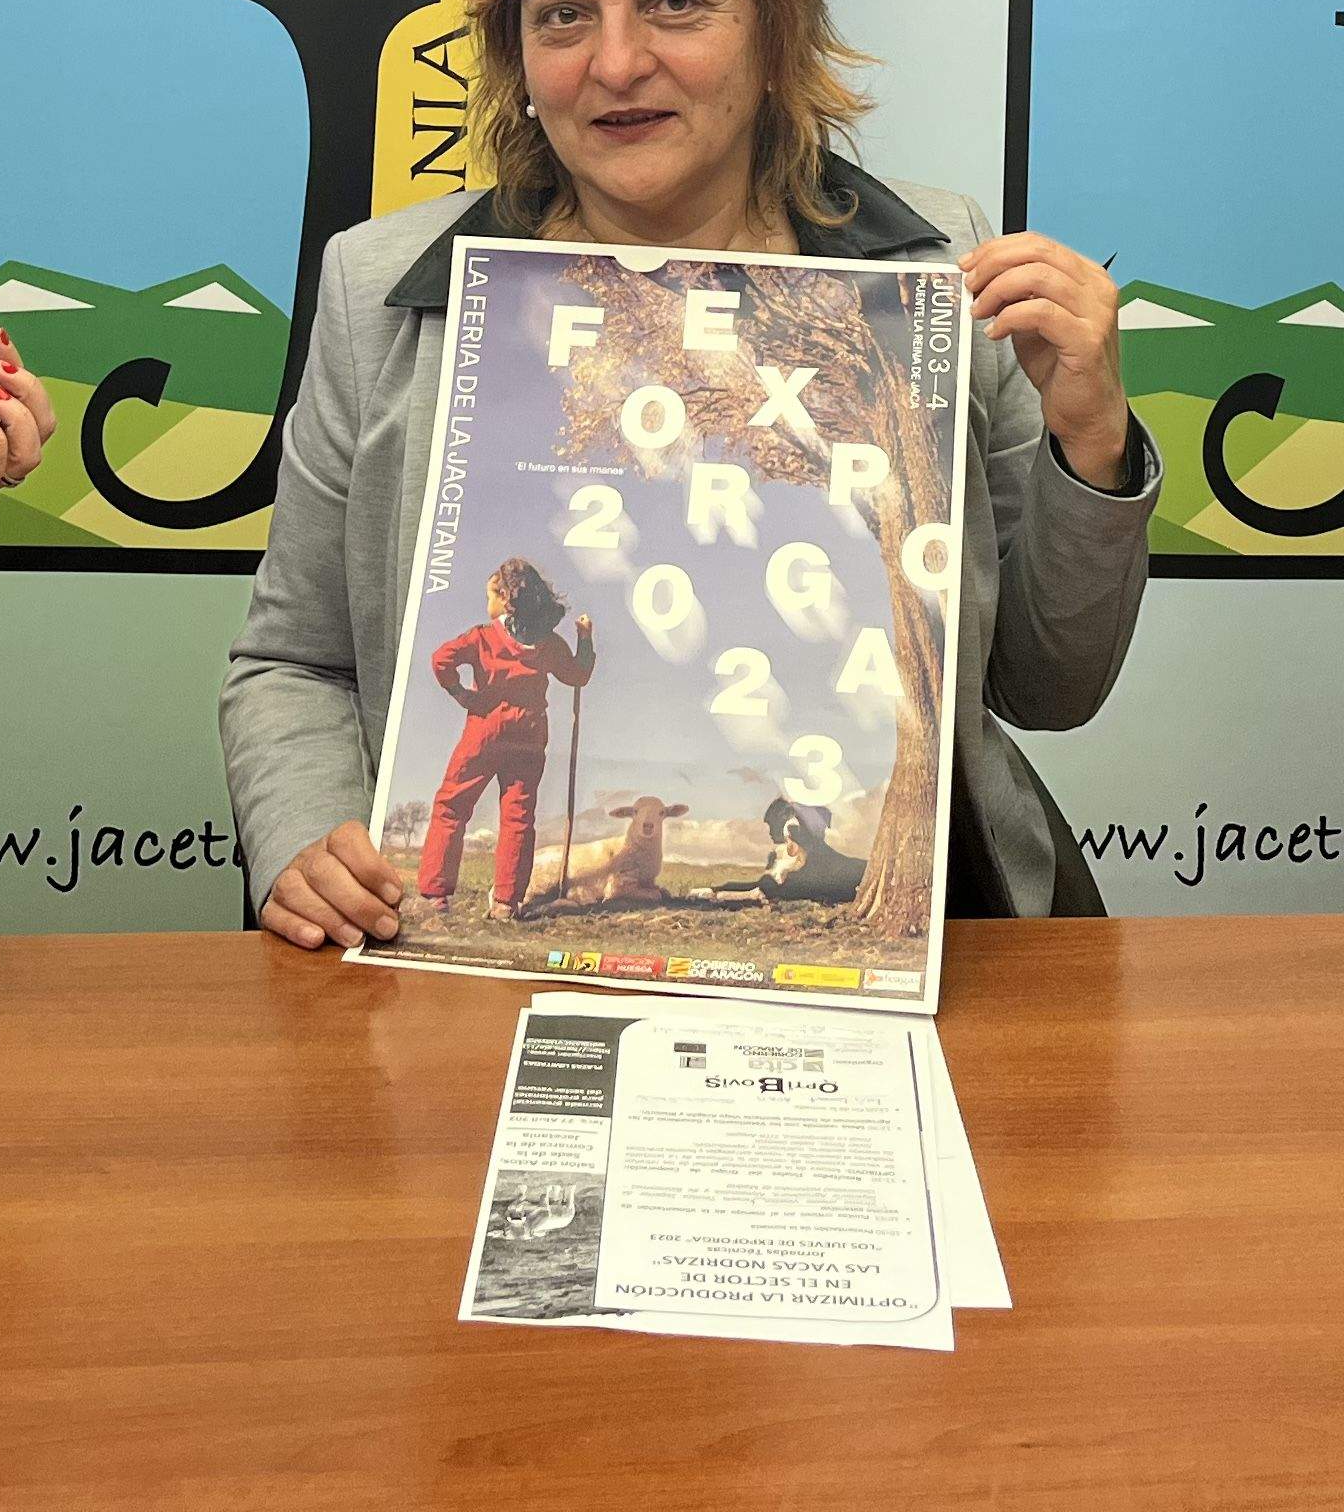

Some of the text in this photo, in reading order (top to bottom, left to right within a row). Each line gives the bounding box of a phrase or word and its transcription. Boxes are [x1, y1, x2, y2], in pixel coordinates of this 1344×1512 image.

[928, 277, 955, 353] JUNIO
[909, 278, 927, 410] PUENTE LA REINA DE JACA
[426, 256, 490, 594] LA FERIA DE LA JACETANIA
[558, 464, 569, 473] en
[771, 1260, 838, 1272] VACAS
[844, 1263, 879, 1274] LAS
[679, 1271, 850, 1289] EN EL SECTOR DE
[613, 1283, 753, 1303] PRODUCCIÓN
[760, 1290, 784, 1302] LA
